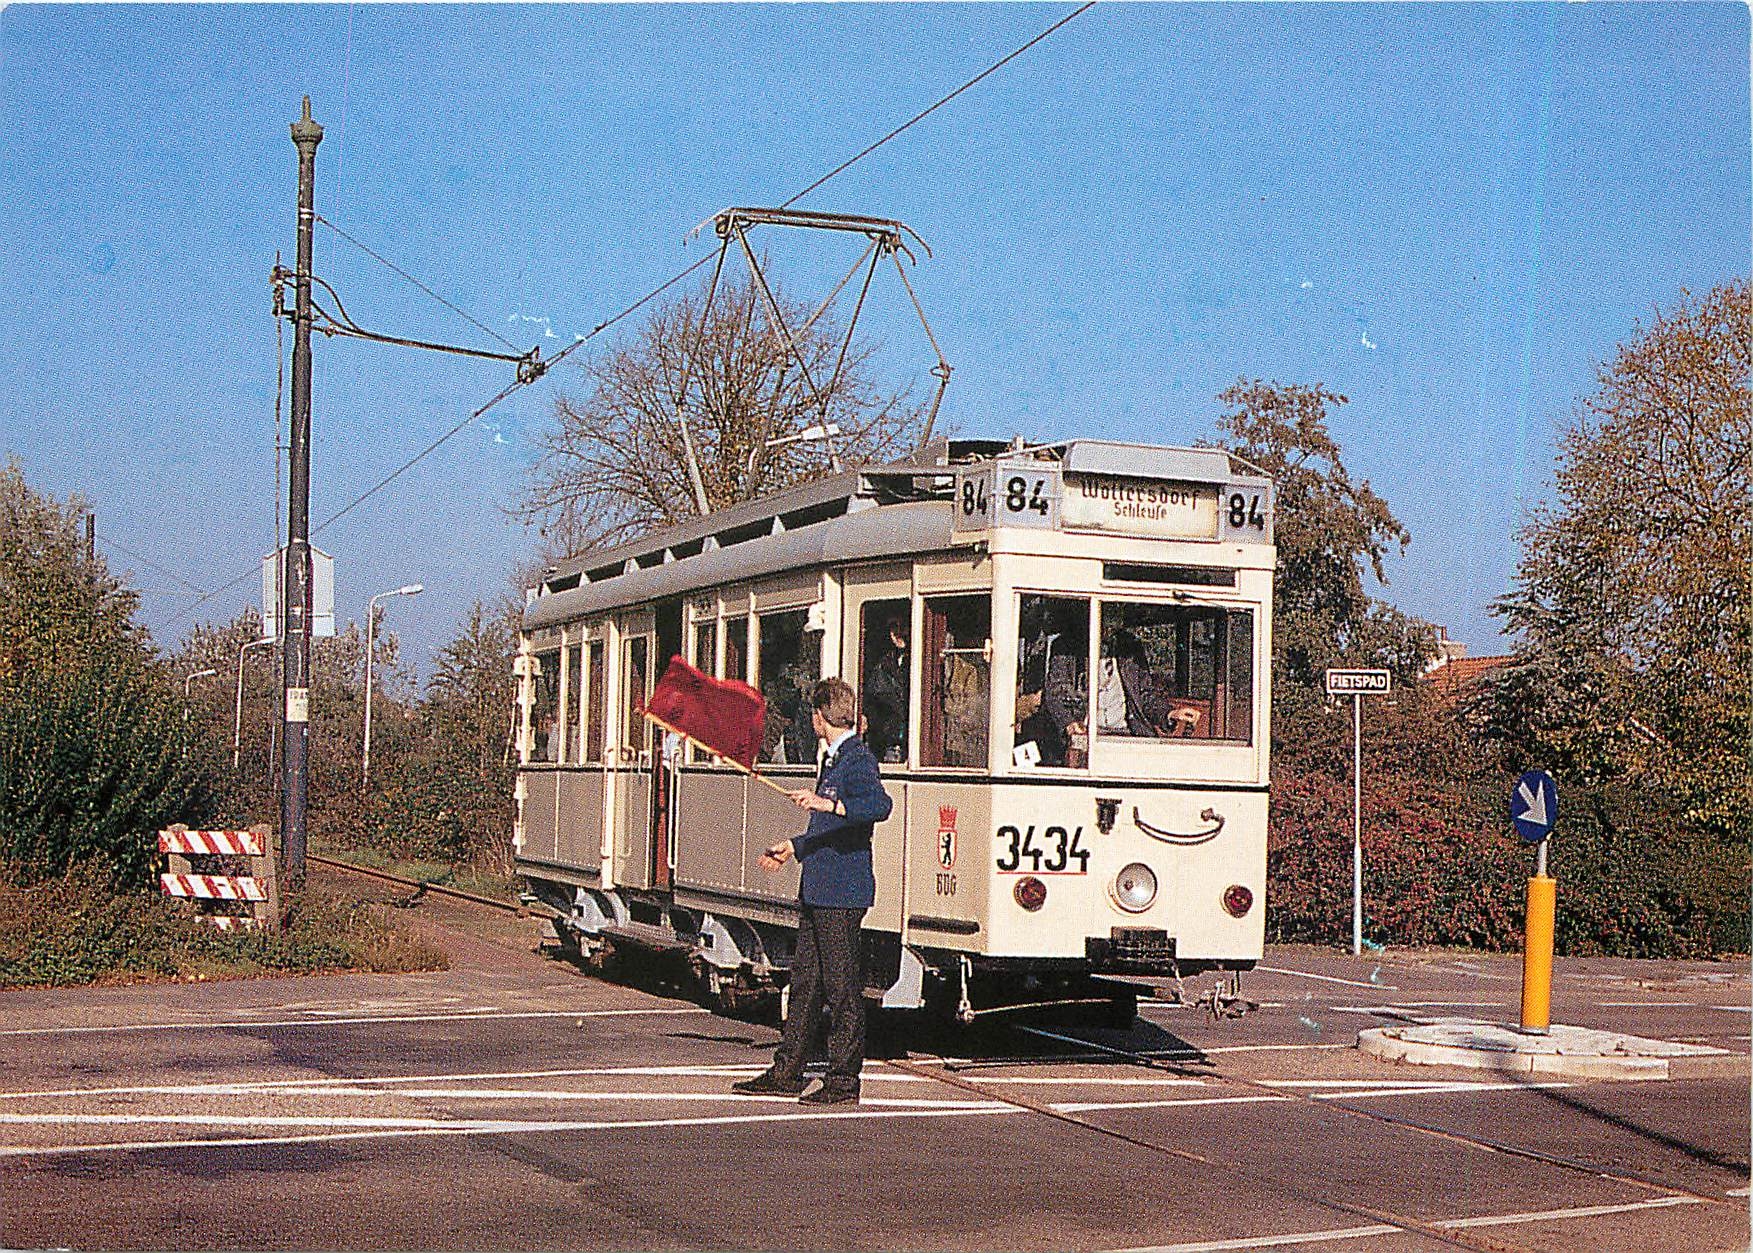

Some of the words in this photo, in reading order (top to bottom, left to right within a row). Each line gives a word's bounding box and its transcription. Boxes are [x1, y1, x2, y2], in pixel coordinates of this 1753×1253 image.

[963, 479, 987, 515] 84
[1006, 476, 1049, 516] 84
[1229, 493, 1265, 531] 84
[1330, 673, 1386, 688] FIETSPAD
[996, 825, 1091, 872] 3434
